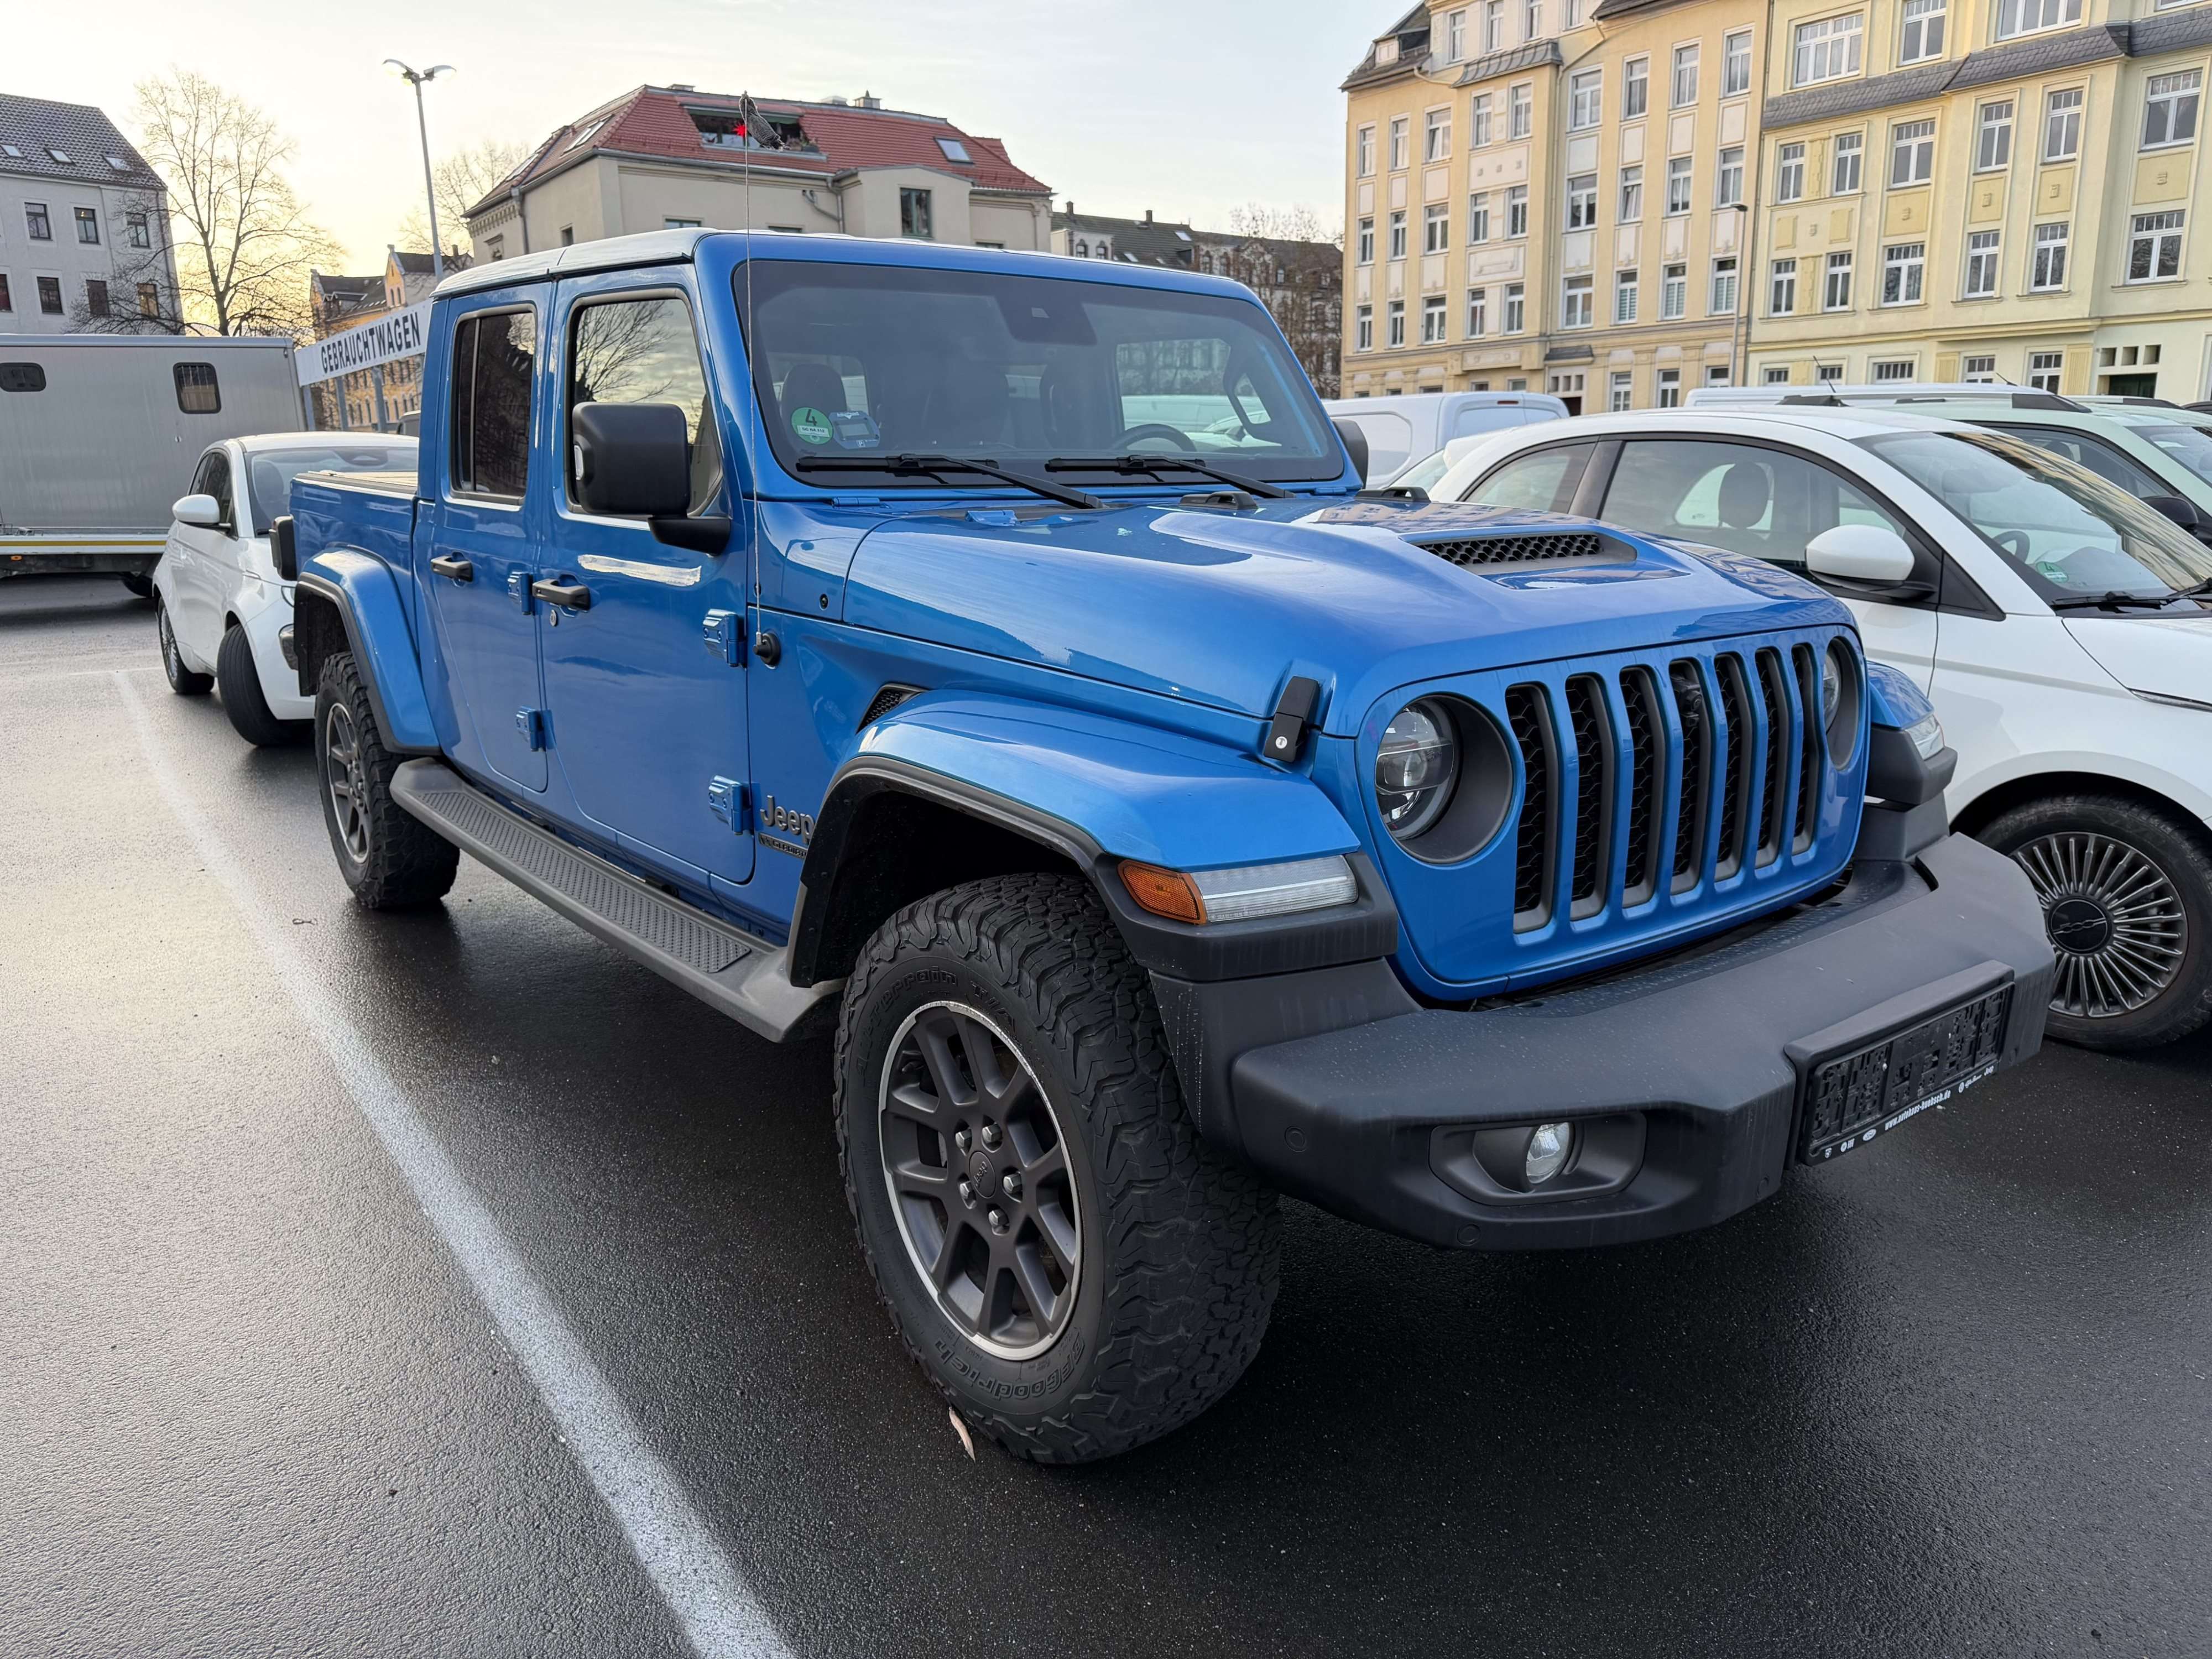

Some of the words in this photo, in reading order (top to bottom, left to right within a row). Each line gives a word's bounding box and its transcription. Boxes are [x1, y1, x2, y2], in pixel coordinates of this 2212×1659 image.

[321, 311, 421, 374] GEBRAUCHTWAGEN
[805, 409, 817, 426] 4
[2044, 562, 2055, 572] 4
[759, 795, 816, 845] Jeep
[1885, 1089, 1952, 1131] www.autohaus-huebsch.de
[973, 1160, 988, 1188] Jeep
[933, 1327, 1086, 1402] BFGoodrich
